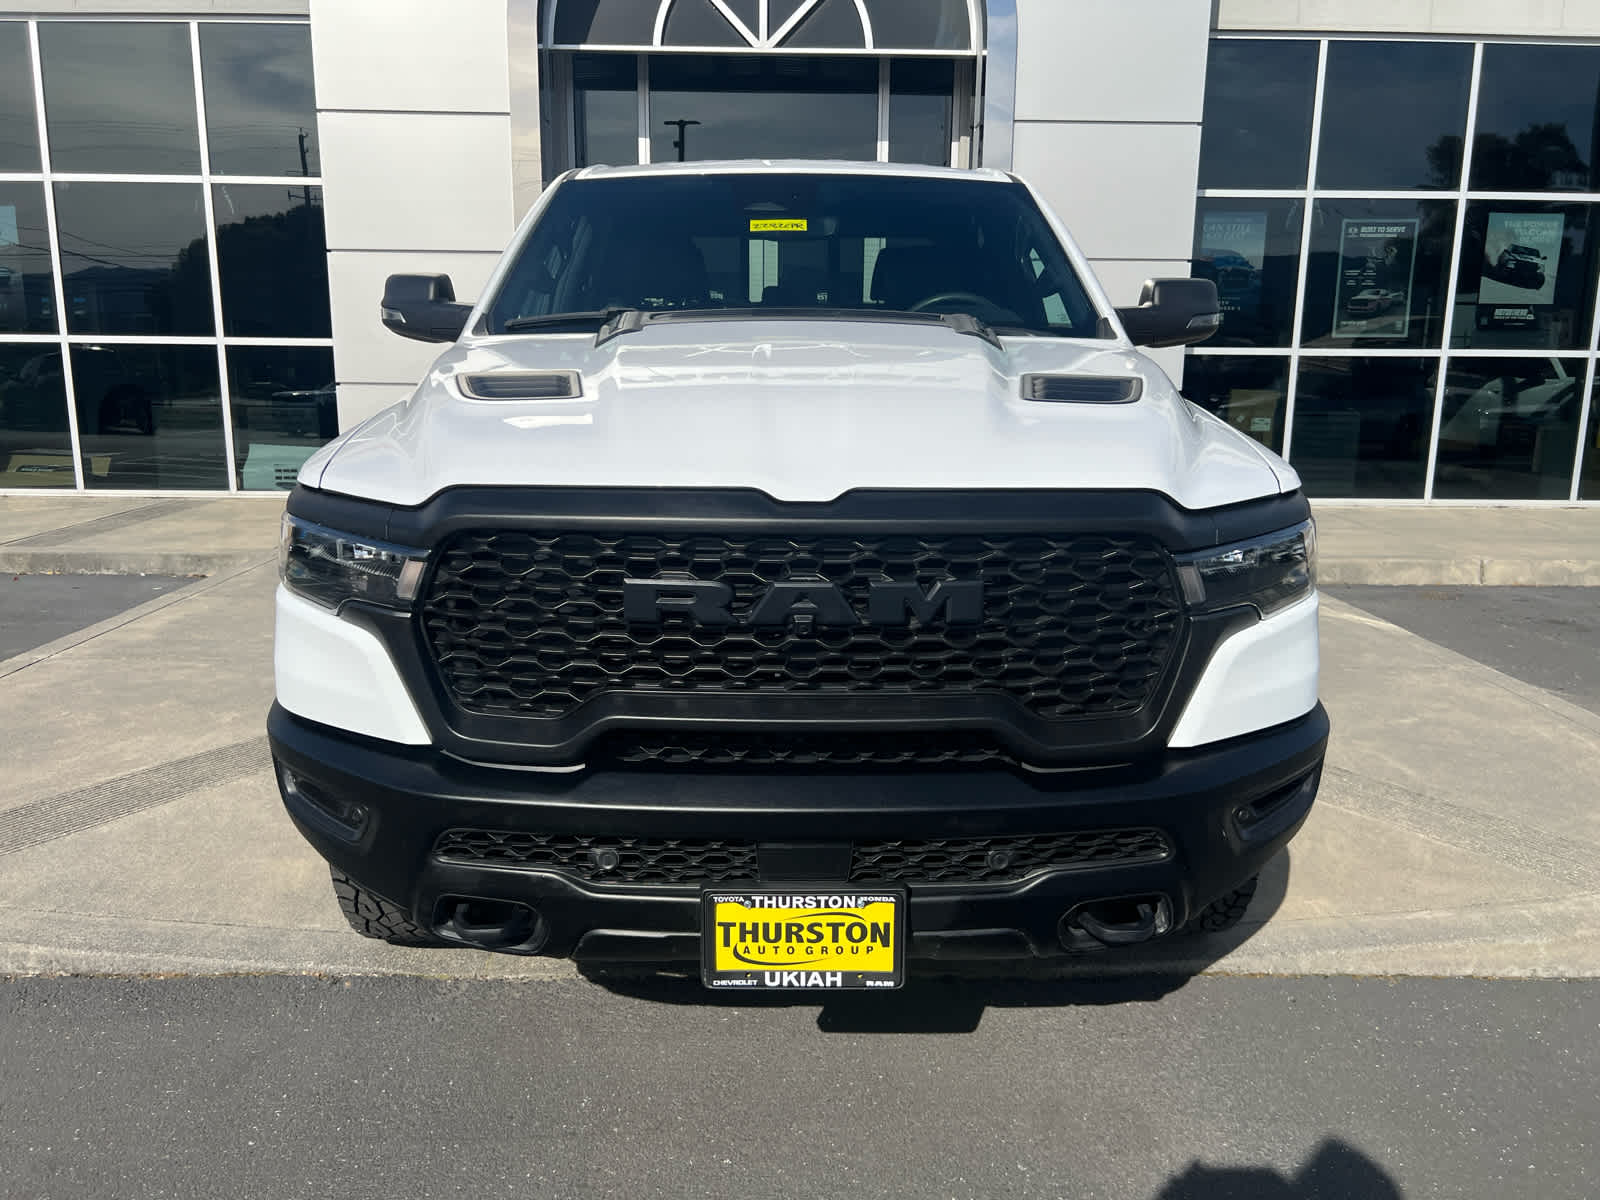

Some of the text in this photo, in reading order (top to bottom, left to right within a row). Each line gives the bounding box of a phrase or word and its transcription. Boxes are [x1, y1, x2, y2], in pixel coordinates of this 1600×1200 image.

[623, 577, 984, 625] RAM
[751, 896, 855, 908] THURSTON
[717, 922, 891, 947] THURSTON
[743, 946, 874, 955] AUTO GROUP
[764, 971, 842, 987] UKIAH
